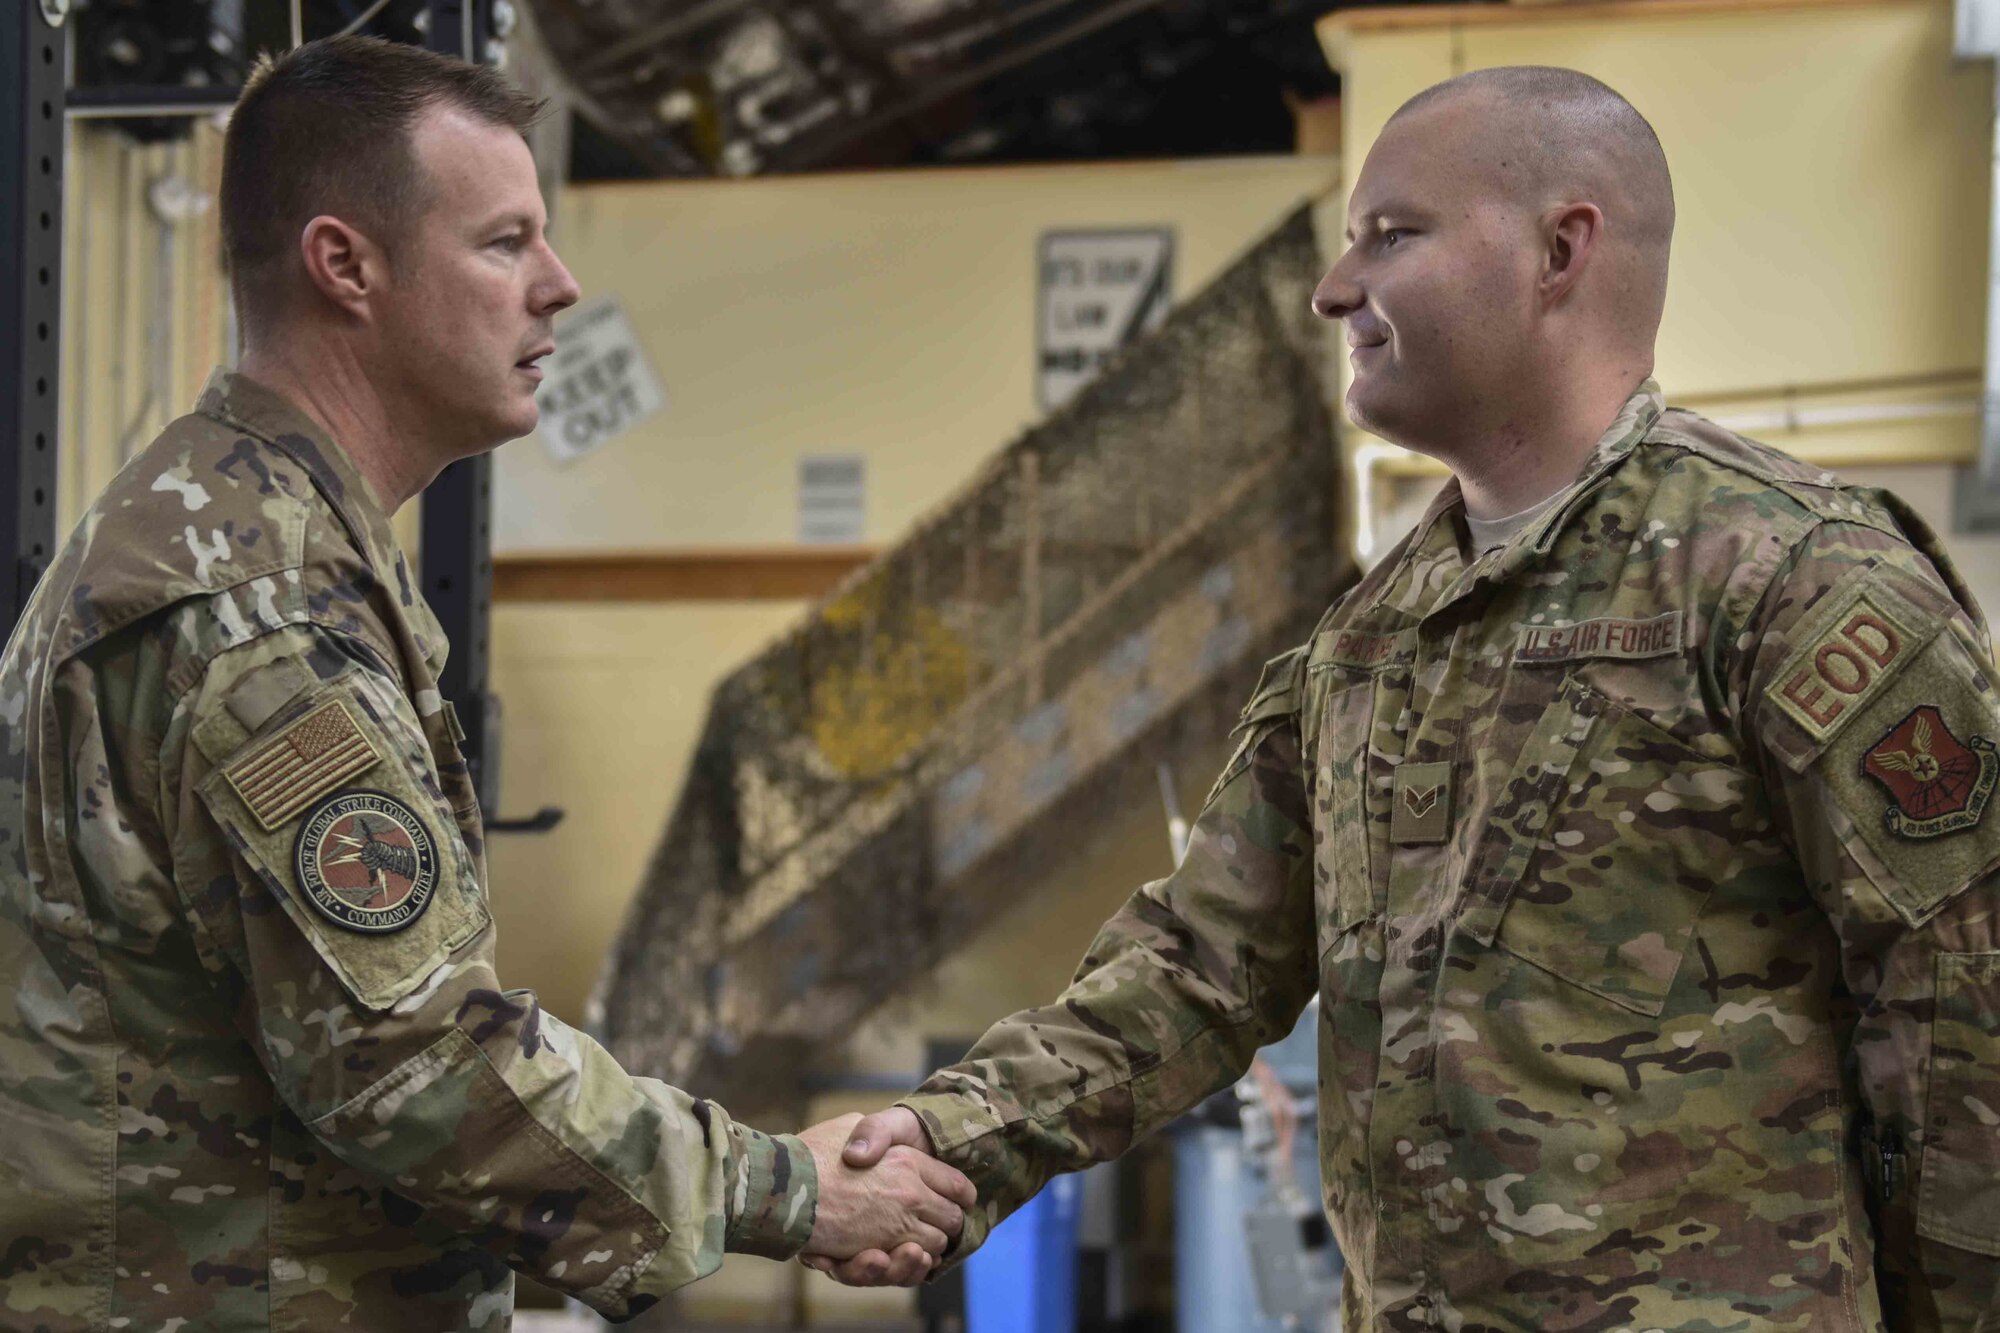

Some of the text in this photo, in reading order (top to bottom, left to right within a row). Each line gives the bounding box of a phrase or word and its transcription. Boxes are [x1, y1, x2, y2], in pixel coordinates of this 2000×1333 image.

[1567, 622, 1601, 654] AIR
[1604, 618, 1674, 653] FORCE
[1782, 613, 1901, 728] EOD
[303, 797, 427, 909] AIR FORCE GLOBAL STRIKE COMMAND
[347, 868, 432, 926] COMMAND CHIEF
